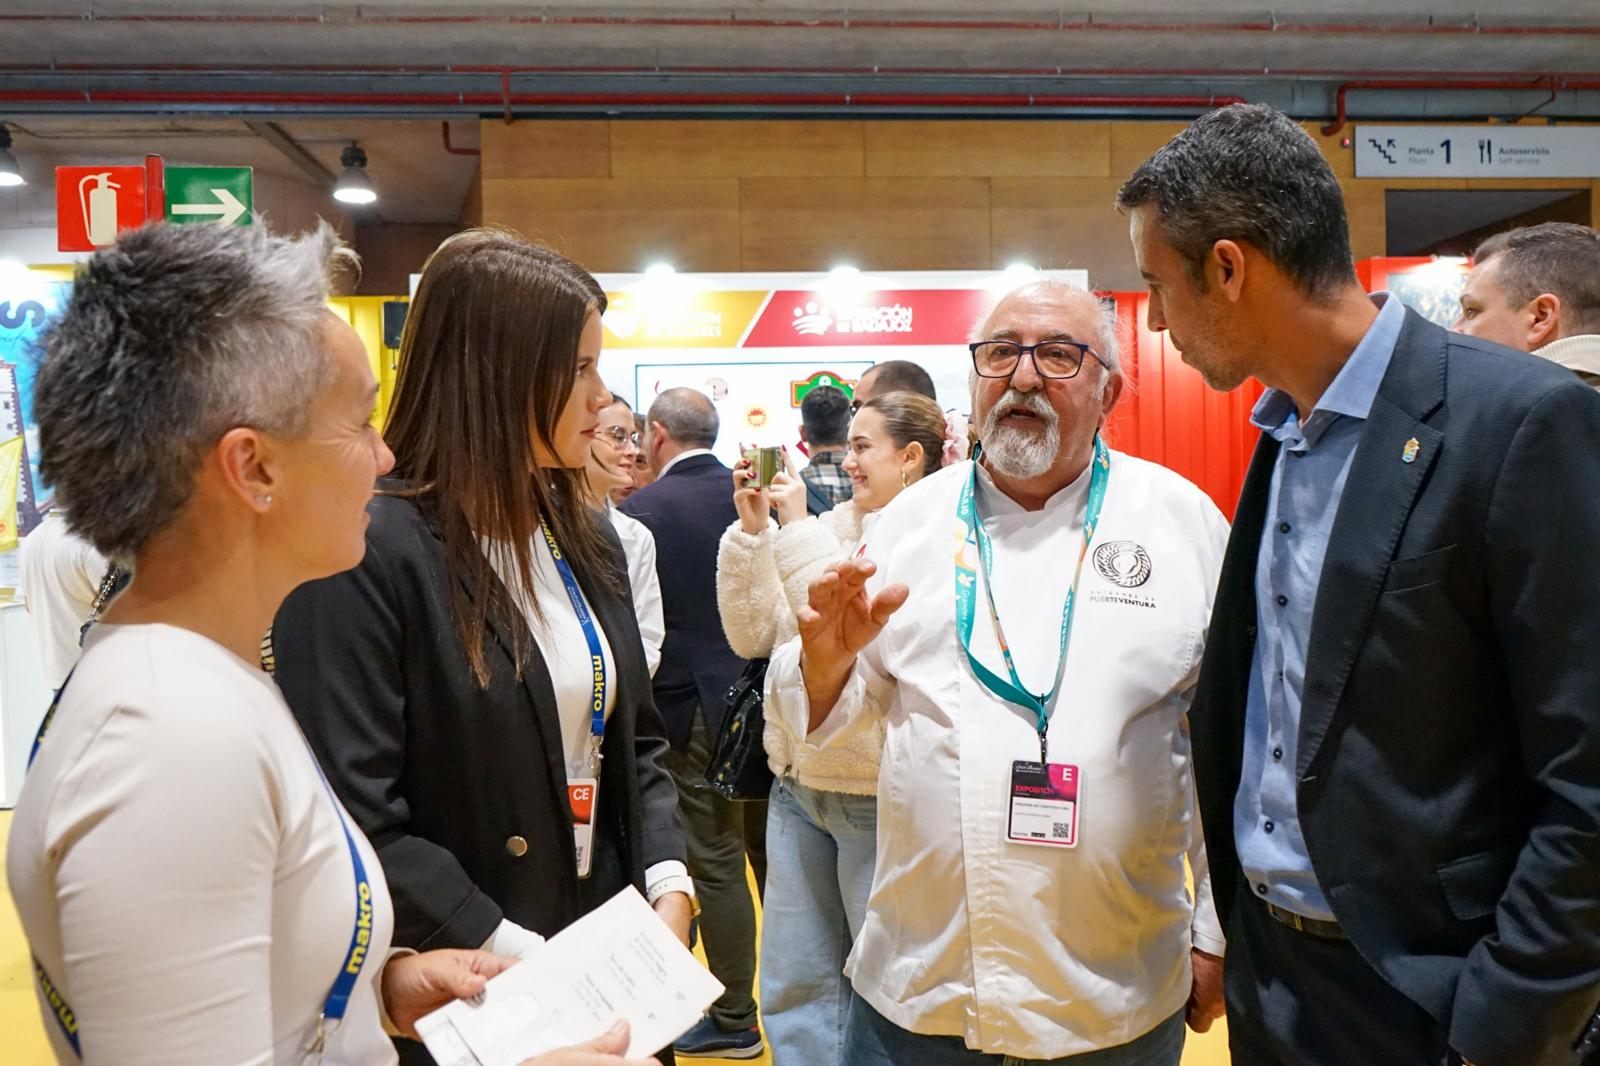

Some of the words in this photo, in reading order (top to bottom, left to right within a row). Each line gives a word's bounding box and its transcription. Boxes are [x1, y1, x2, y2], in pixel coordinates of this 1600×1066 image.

[1440, 138, 1451, 164] 1
[1090, 596, 1156, 609] FUERTEVENTURA
[592, 654, 603, 712] makro
[1062, 767, 1073, 781] E
[572, 787, 590, 801] CE
[346, 882, 371, 974] makro
